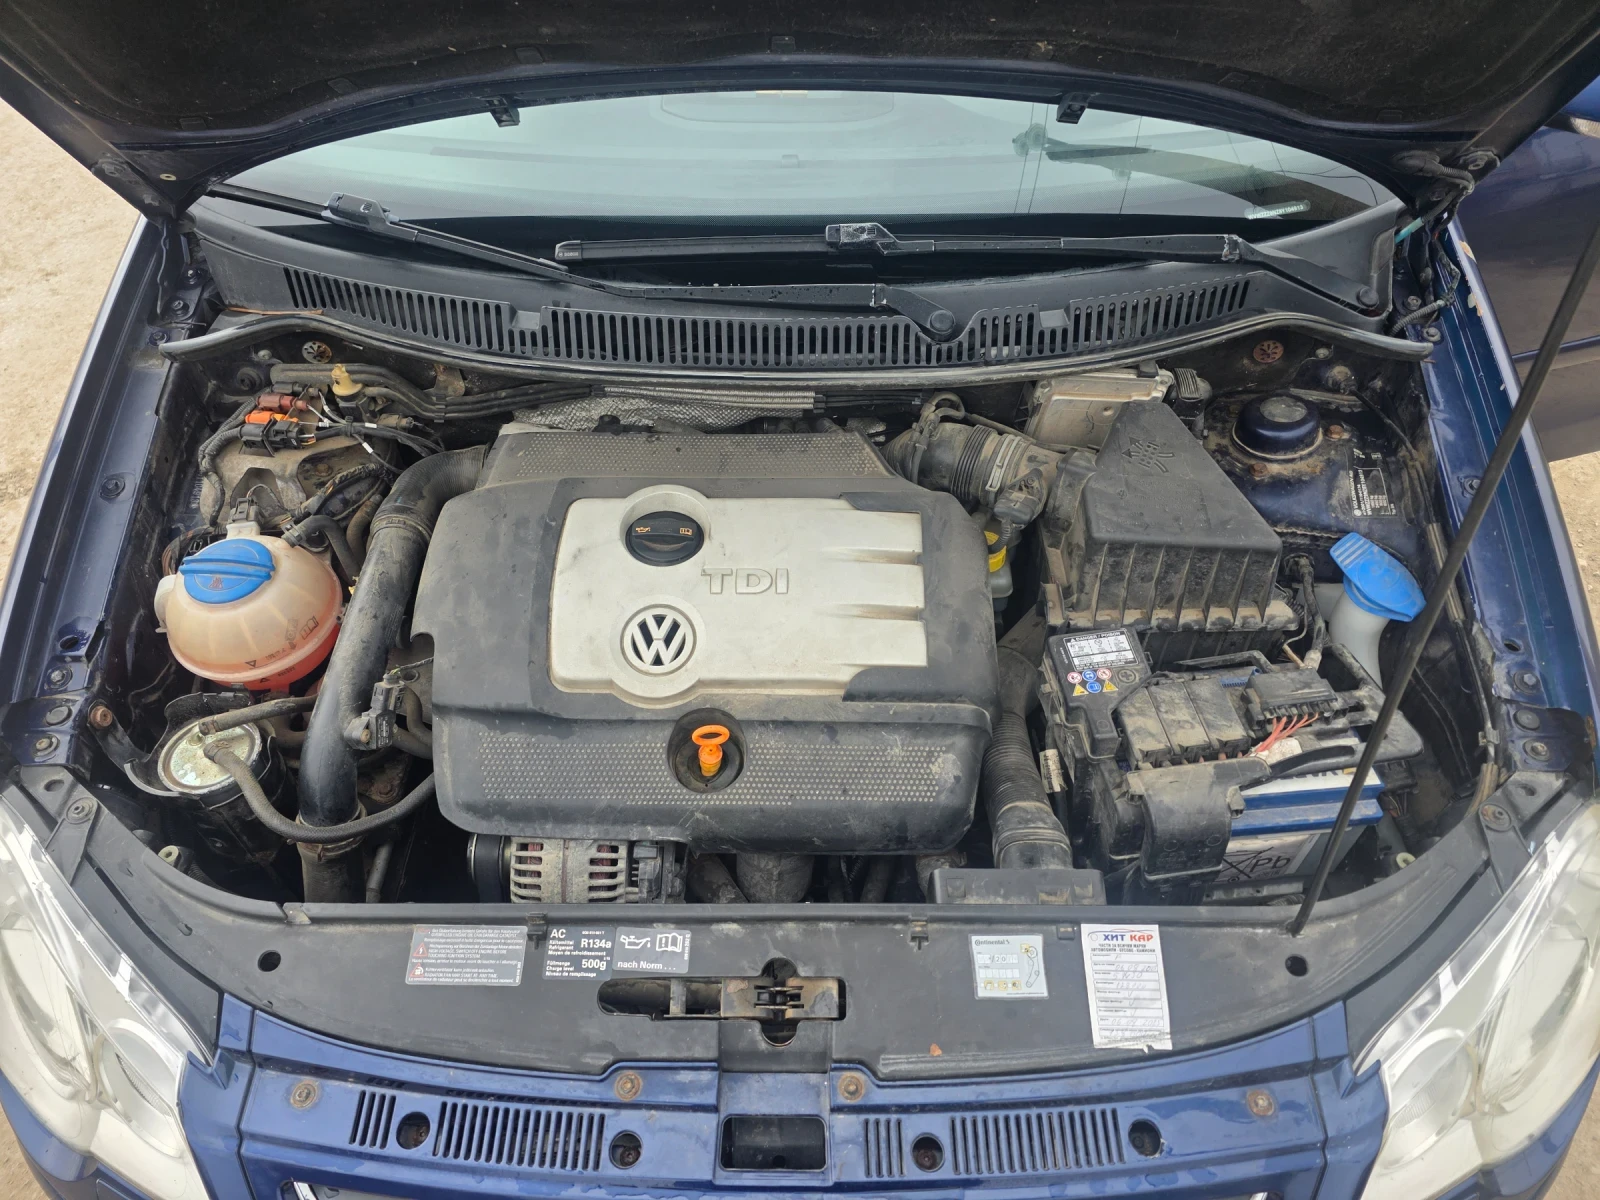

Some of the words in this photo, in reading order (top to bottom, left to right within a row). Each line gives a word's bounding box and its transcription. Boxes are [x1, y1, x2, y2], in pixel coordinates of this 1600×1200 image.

[700, 567, 789, 595] TDI
[1250, 856, 1291, 873] Pb
[550, 928, 566, 939] AC
[1103, 934, 1126, 942] ХИТ
[1129, 934, 1154, 942] КАР
[581, 938, 612, 949] R134a
[582, 958, 607, 971] 500g
[617, 960, 638, 969] nach
[639, 961, 663, 970] Norm
